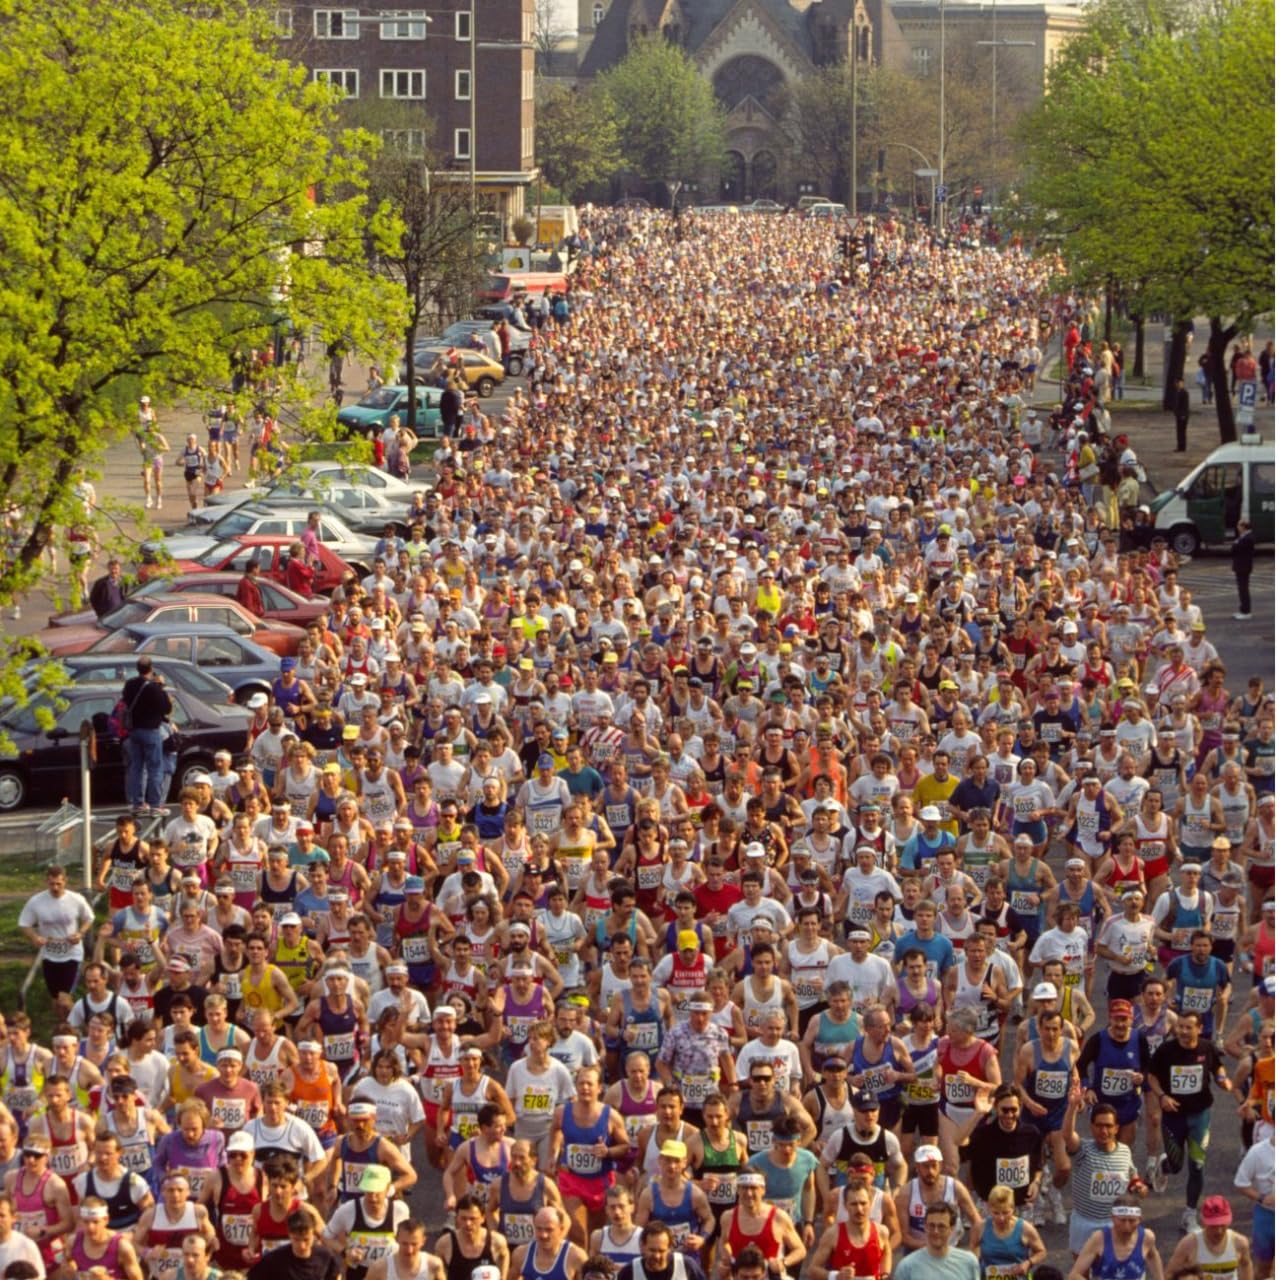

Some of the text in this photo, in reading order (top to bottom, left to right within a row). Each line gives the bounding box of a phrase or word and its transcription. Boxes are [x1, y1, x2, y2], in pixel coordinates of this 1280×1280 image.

[1242, 384, 1254, 403] P
[1037, 1079, 1063, 1094] 8298
[1103, 1075, 1129, 1091] 578
[1172, 1074, 1198, 1090] 579
[523, 1094, 550, 1110] F787
[749, 1129, 770, 1146] 575
[569, 1153, 597, 1169] 1997
[999, 1166, 1026, 1184] 8005
[1092, 1180, 1122, 1197] 8002
[506, 1223, 535, 1239] 5819
